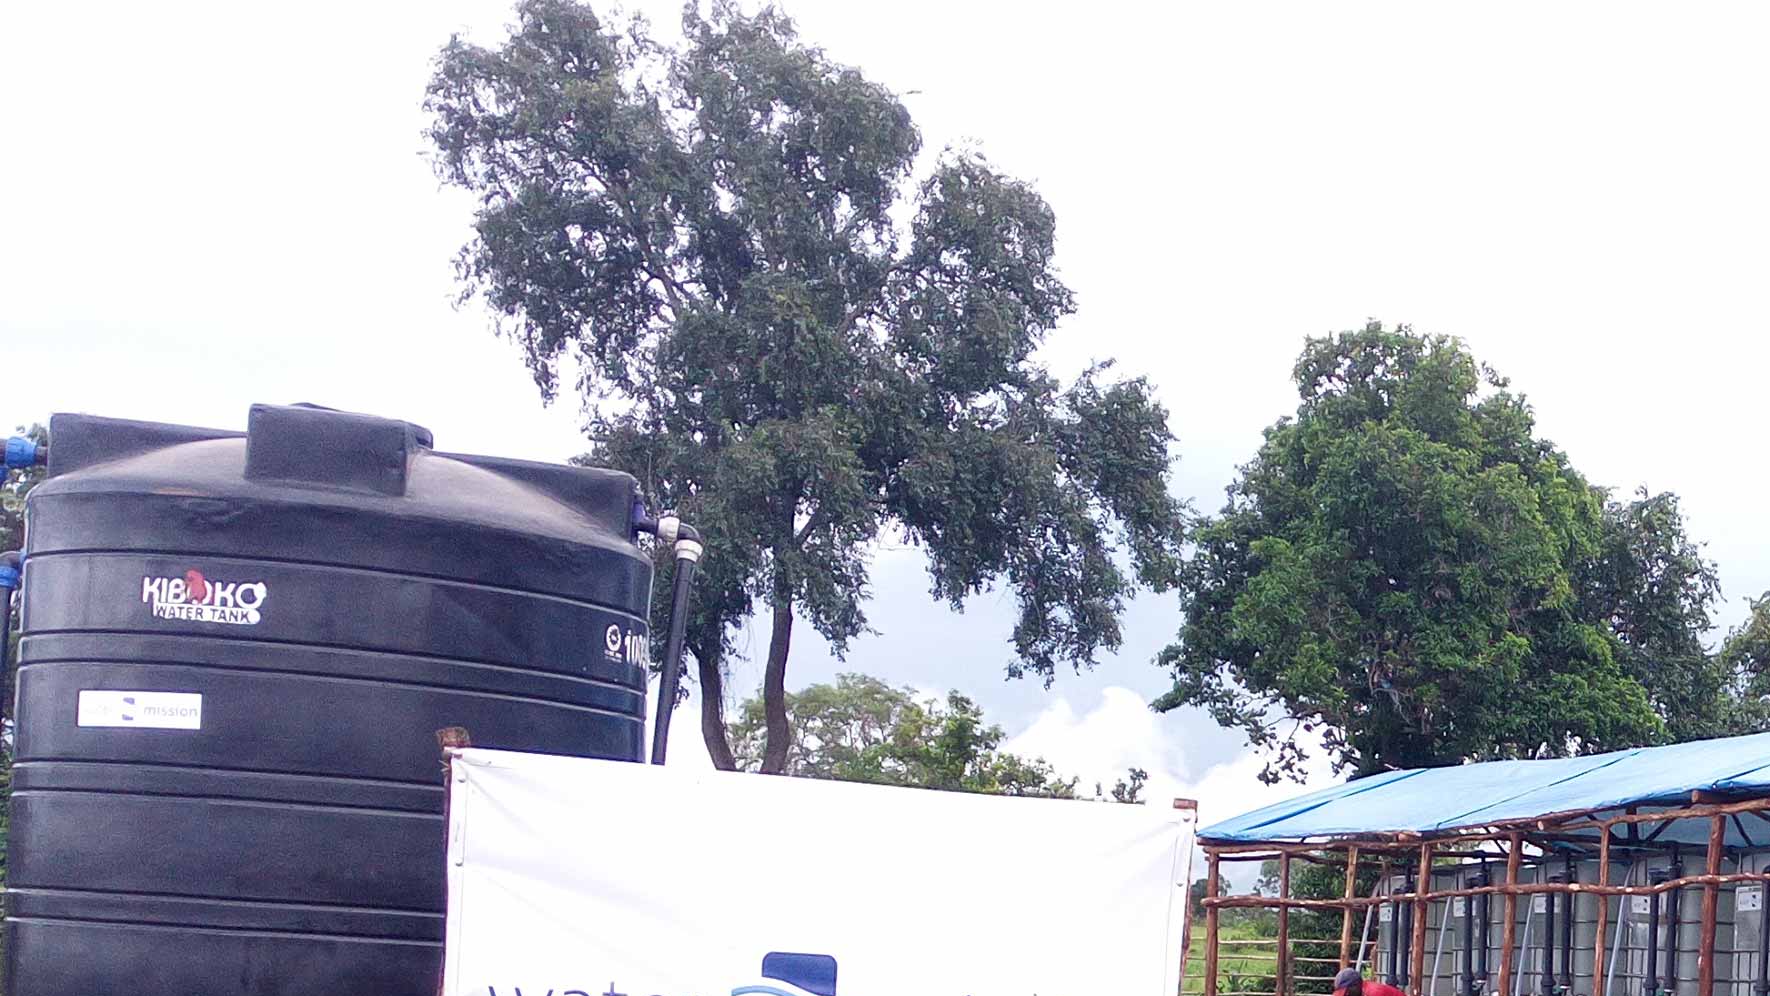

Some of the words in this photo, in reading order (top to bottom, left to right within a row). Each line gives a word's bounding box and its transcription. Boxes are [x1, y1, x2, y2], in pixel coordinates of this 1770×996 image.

[142, 577, 267, 609] KIBOKO
[155, 605, 204, 619] WATER
[210, 608, 250, 623] TANK
[144, 706, 199, 717] mission
